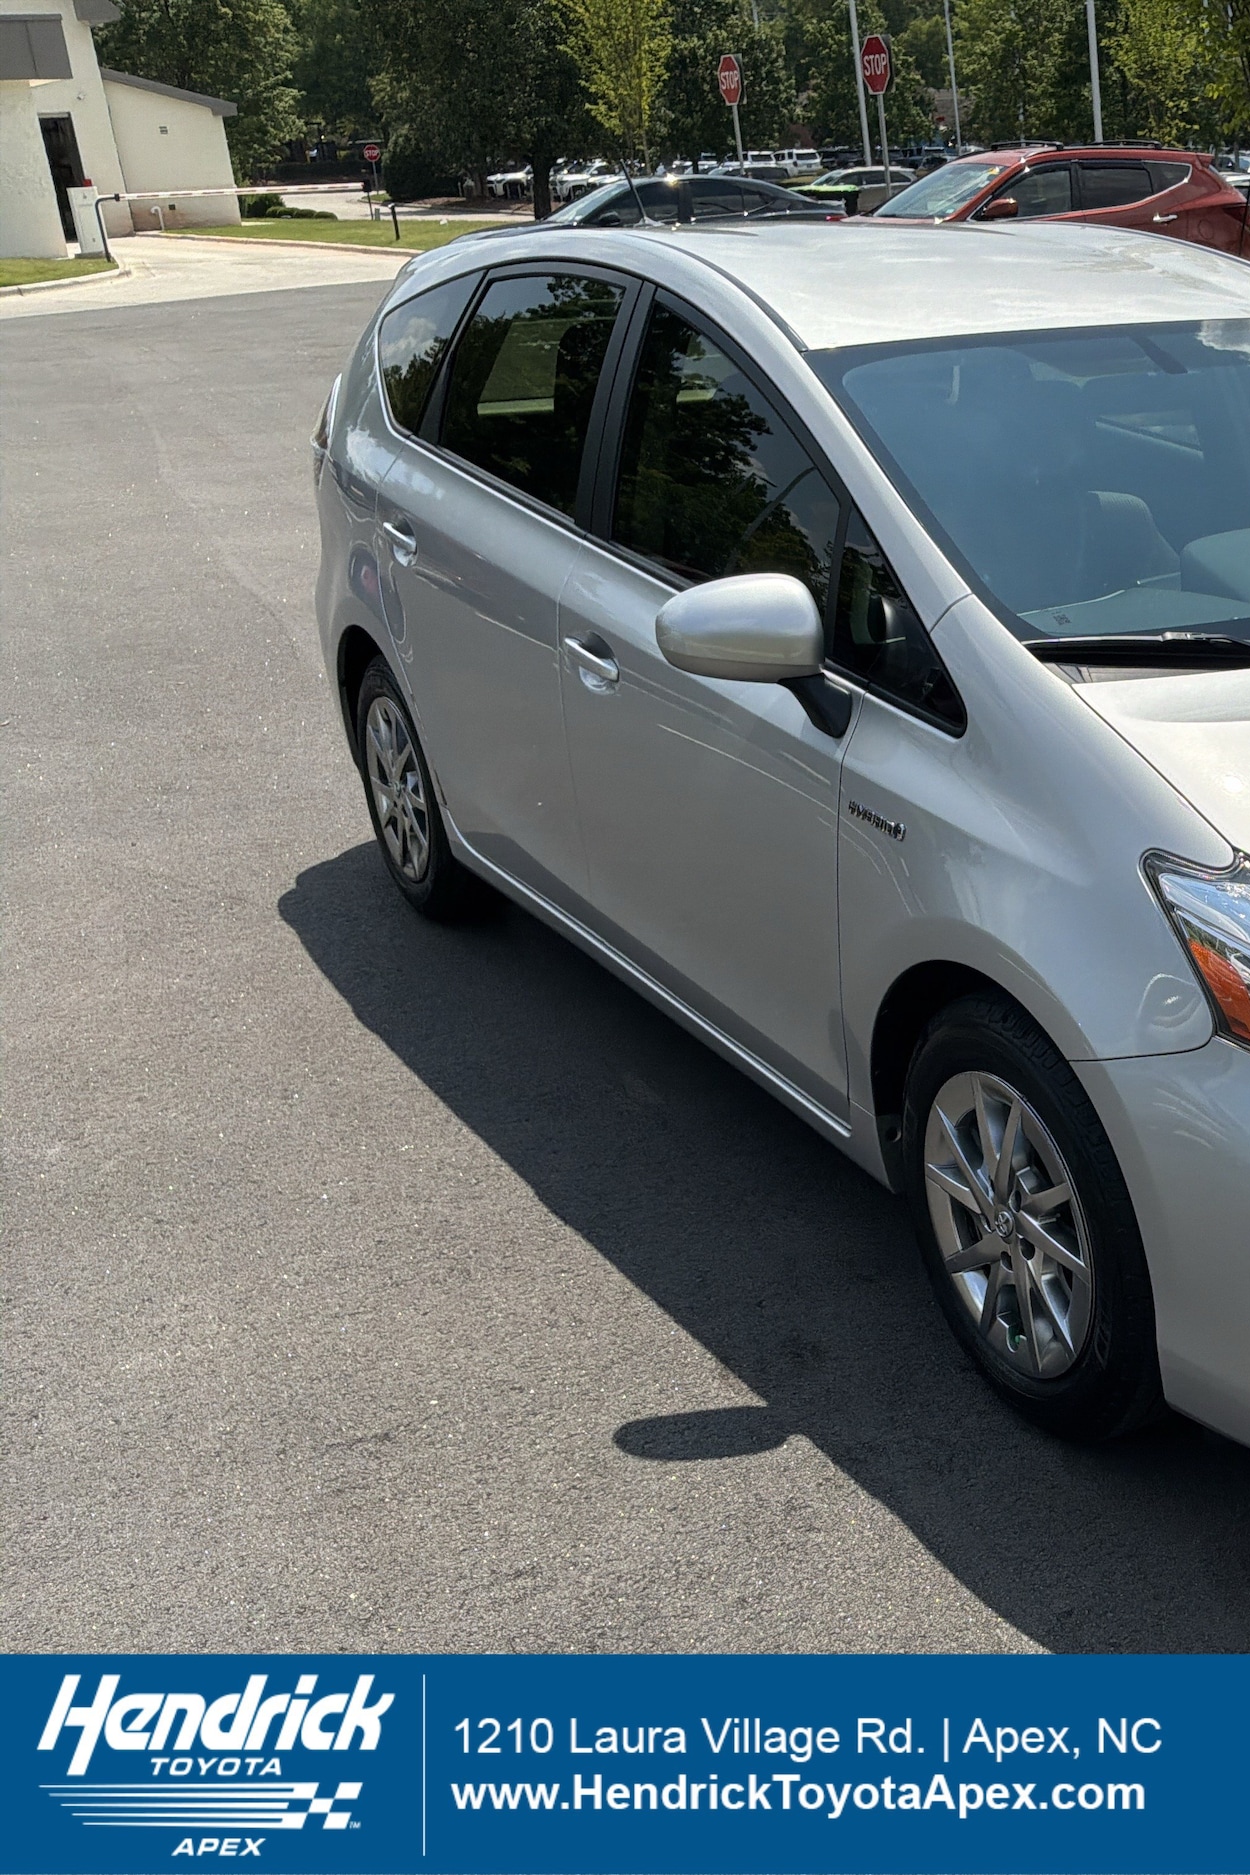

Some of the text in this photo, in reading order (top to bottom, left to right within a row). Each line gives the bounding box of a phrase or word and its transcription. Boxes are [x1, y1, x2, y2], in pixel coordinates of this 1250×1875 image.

[863, 53, 887, 77] STOP
[720, 70, 739, 90] STOP
[364, 149, 380, 157] STOP
[848, 799, 895, 837] HYBRID
